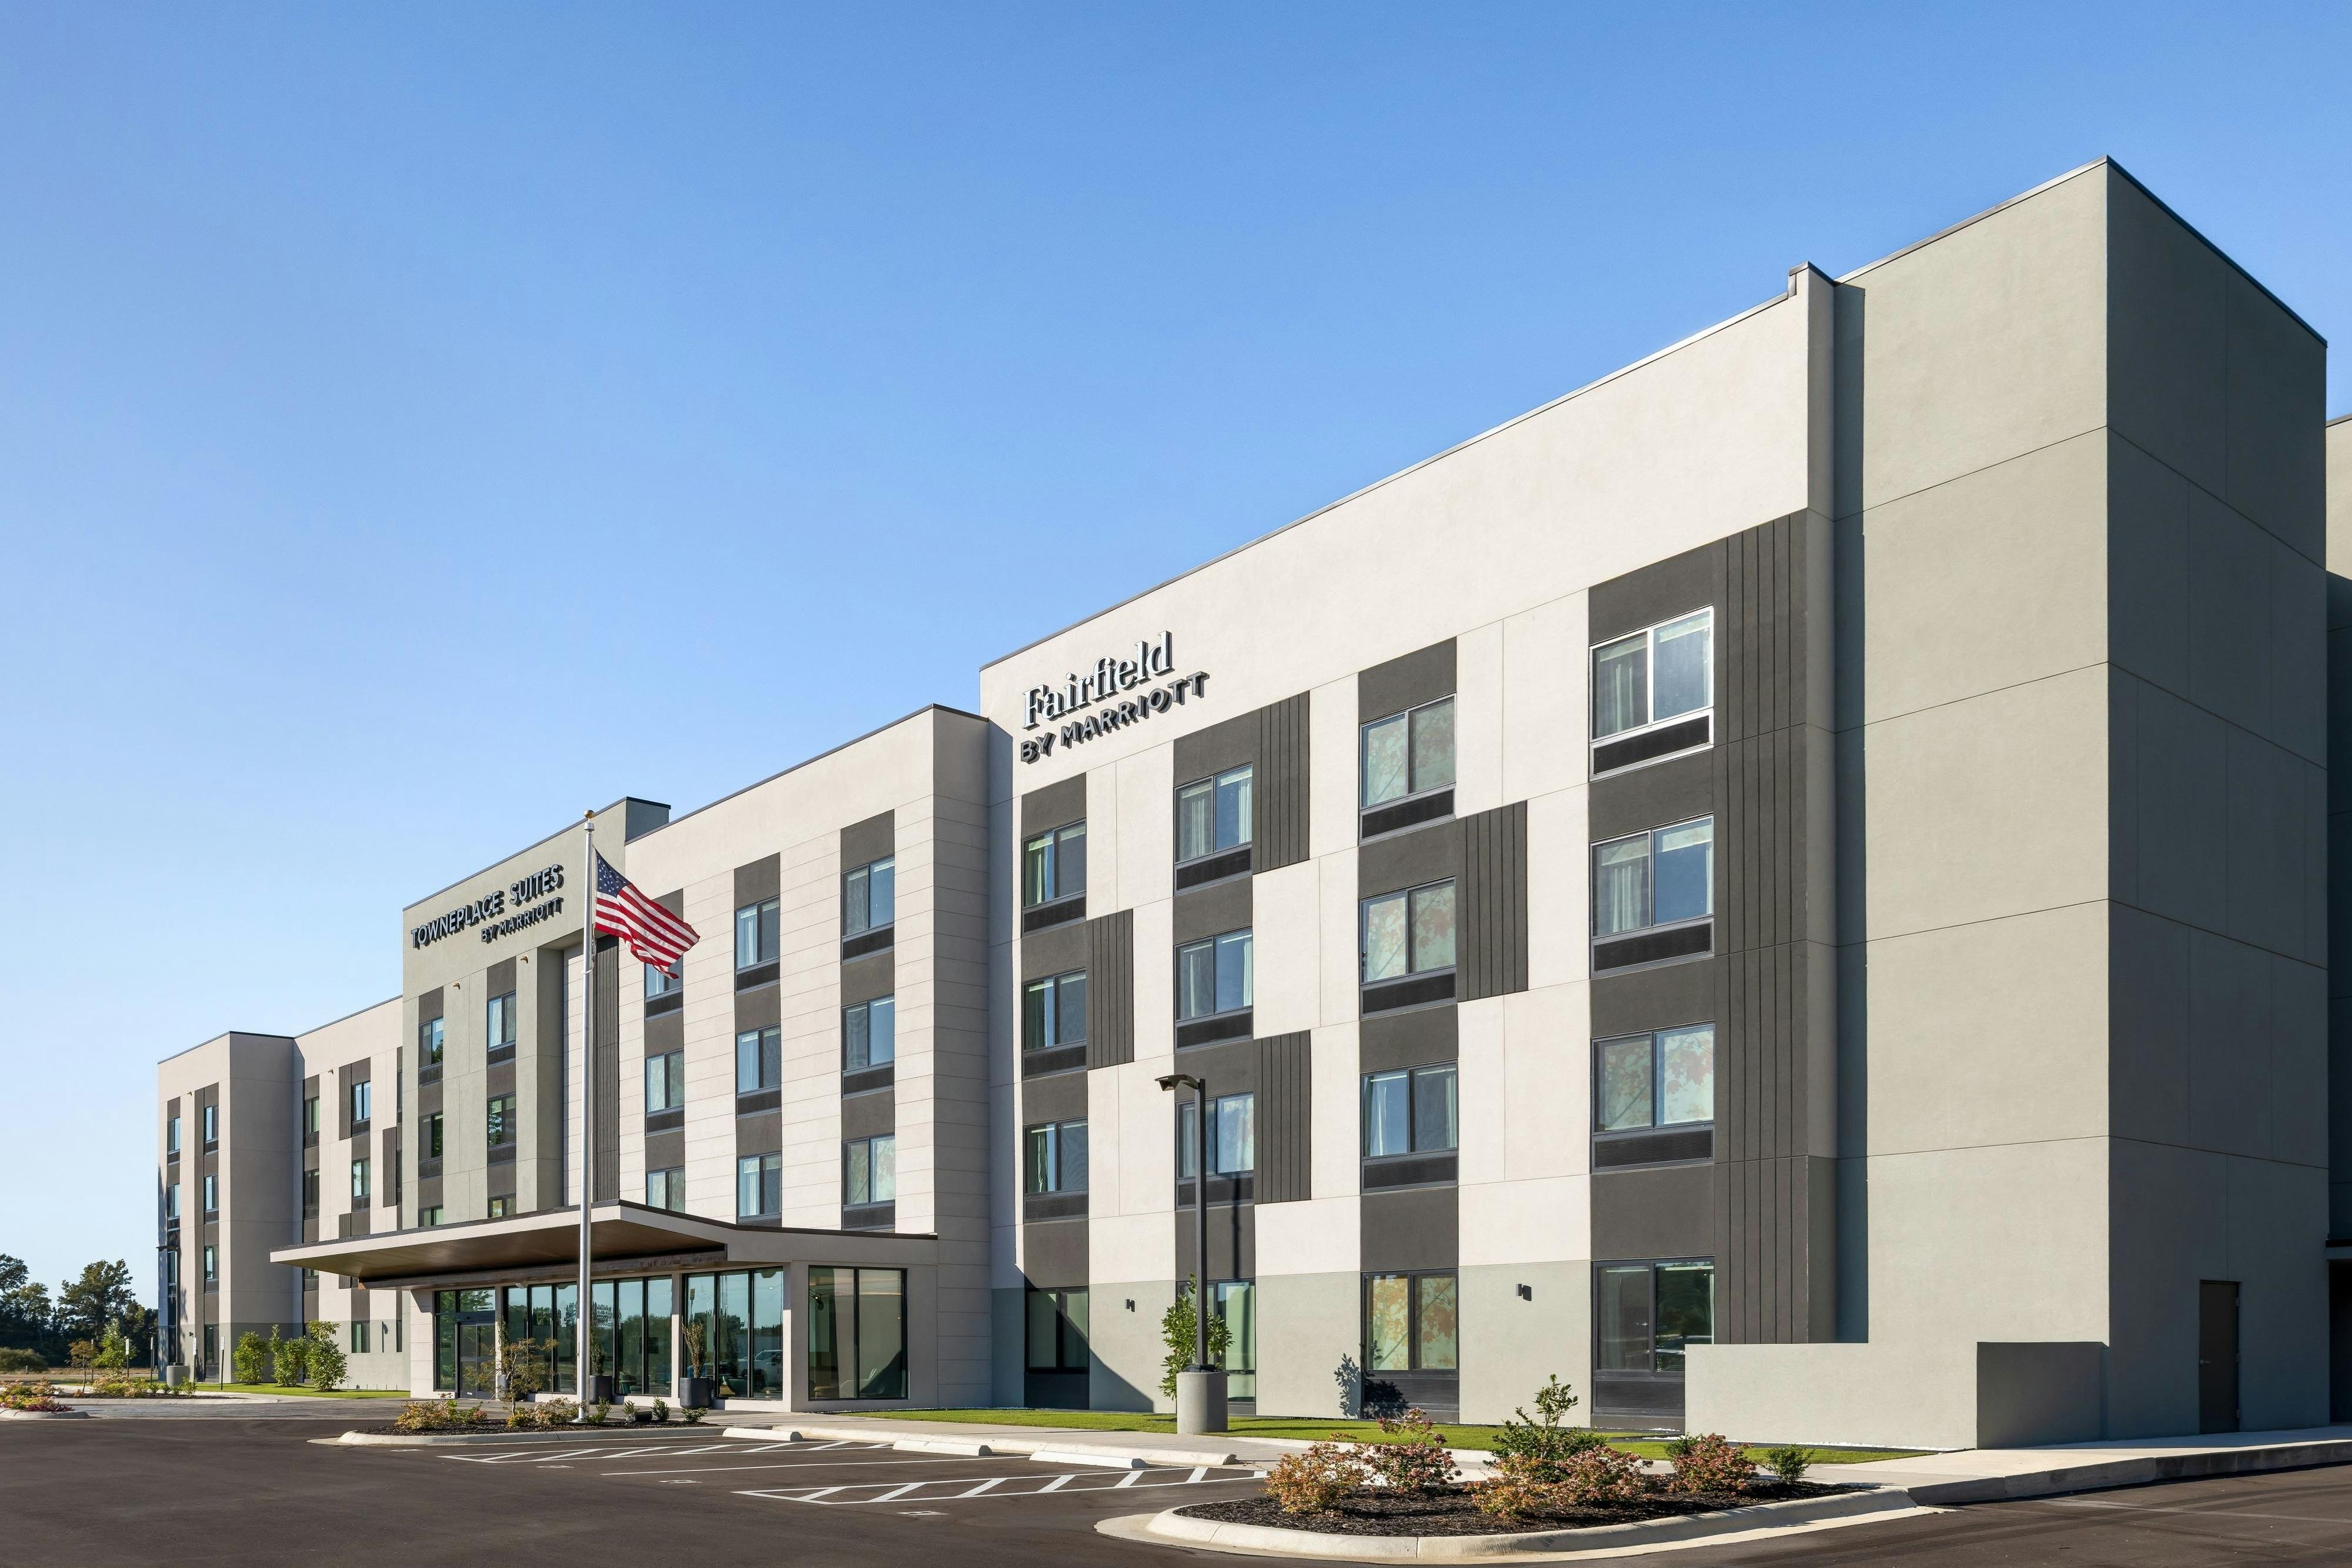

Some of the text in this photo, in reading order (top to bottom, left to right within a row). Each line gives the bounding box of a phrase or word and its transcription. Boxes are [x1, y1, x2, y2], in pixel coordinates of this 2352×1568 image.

[1020, 671, 1210, 764] BY MARRIOTT
[1022, 630, 1175, 731] Fairfield
[410, 864, 564, 949] TOWNEPLACE SUITES
[481, 897, 564, 944] BY MARRIOTT
